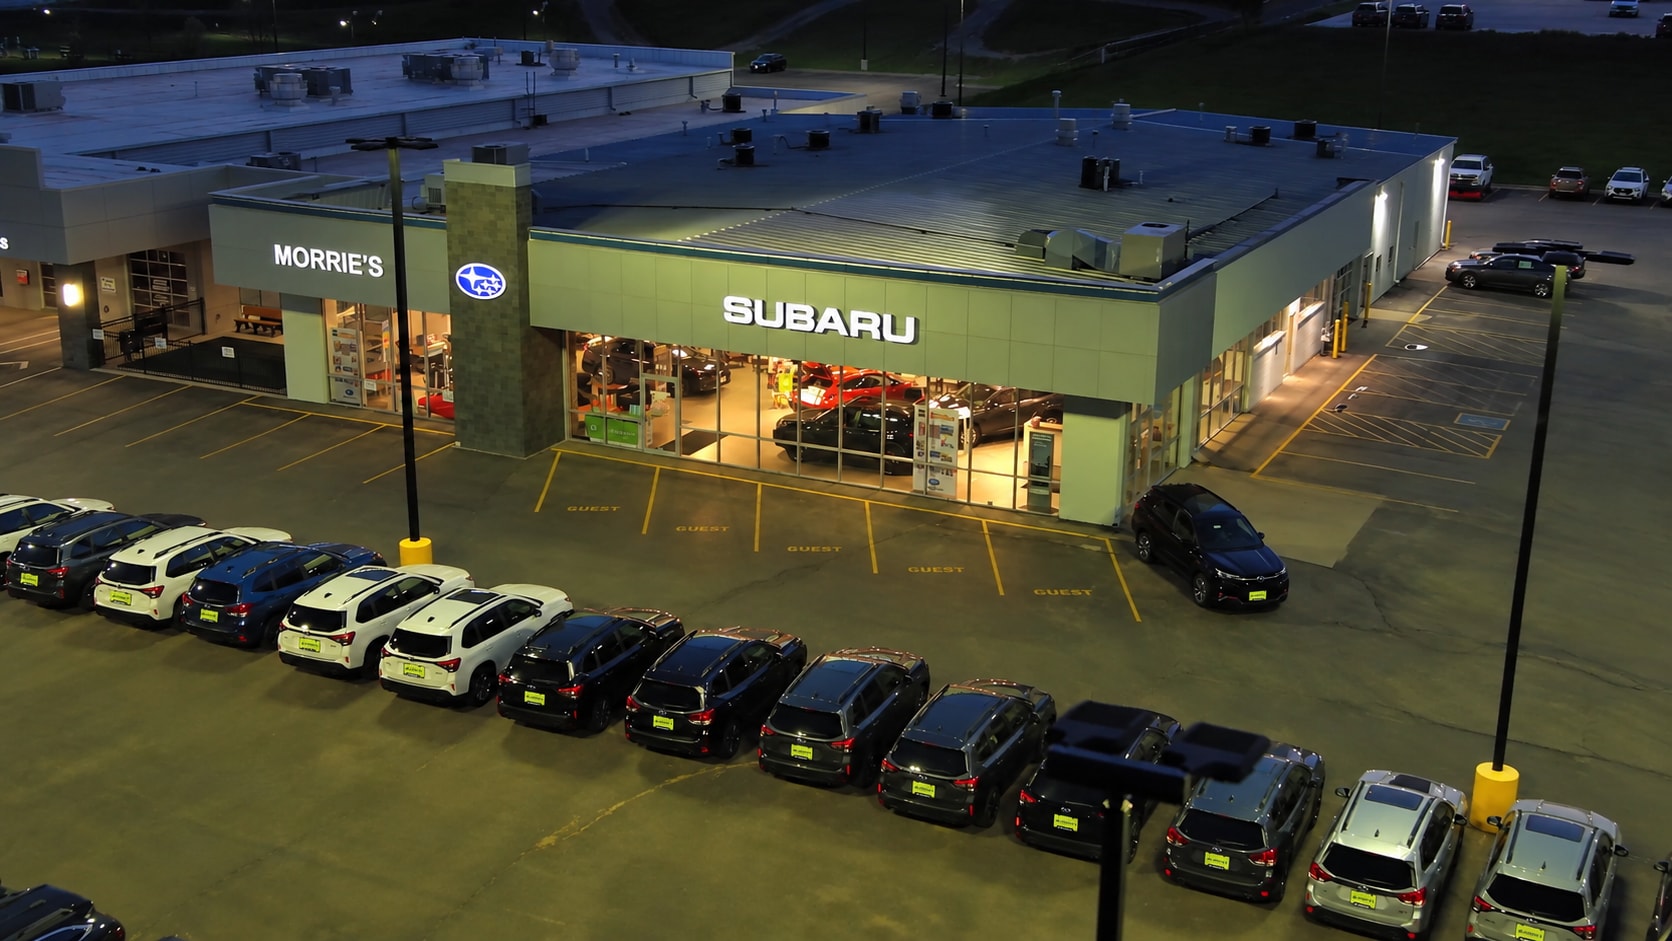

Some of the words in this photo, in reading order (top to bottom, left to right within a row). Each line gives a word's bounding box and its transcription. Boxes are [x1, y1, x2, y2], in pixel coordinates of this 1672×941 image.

[274, 243, 384, 278] MORRIE'S
[723, 295, 918, 344] SUBARU
[676, 525, 730, 533] GUEST
[787, 545, 842, 553] GUEST
[1033, 588, 1093, 596] GUEST
